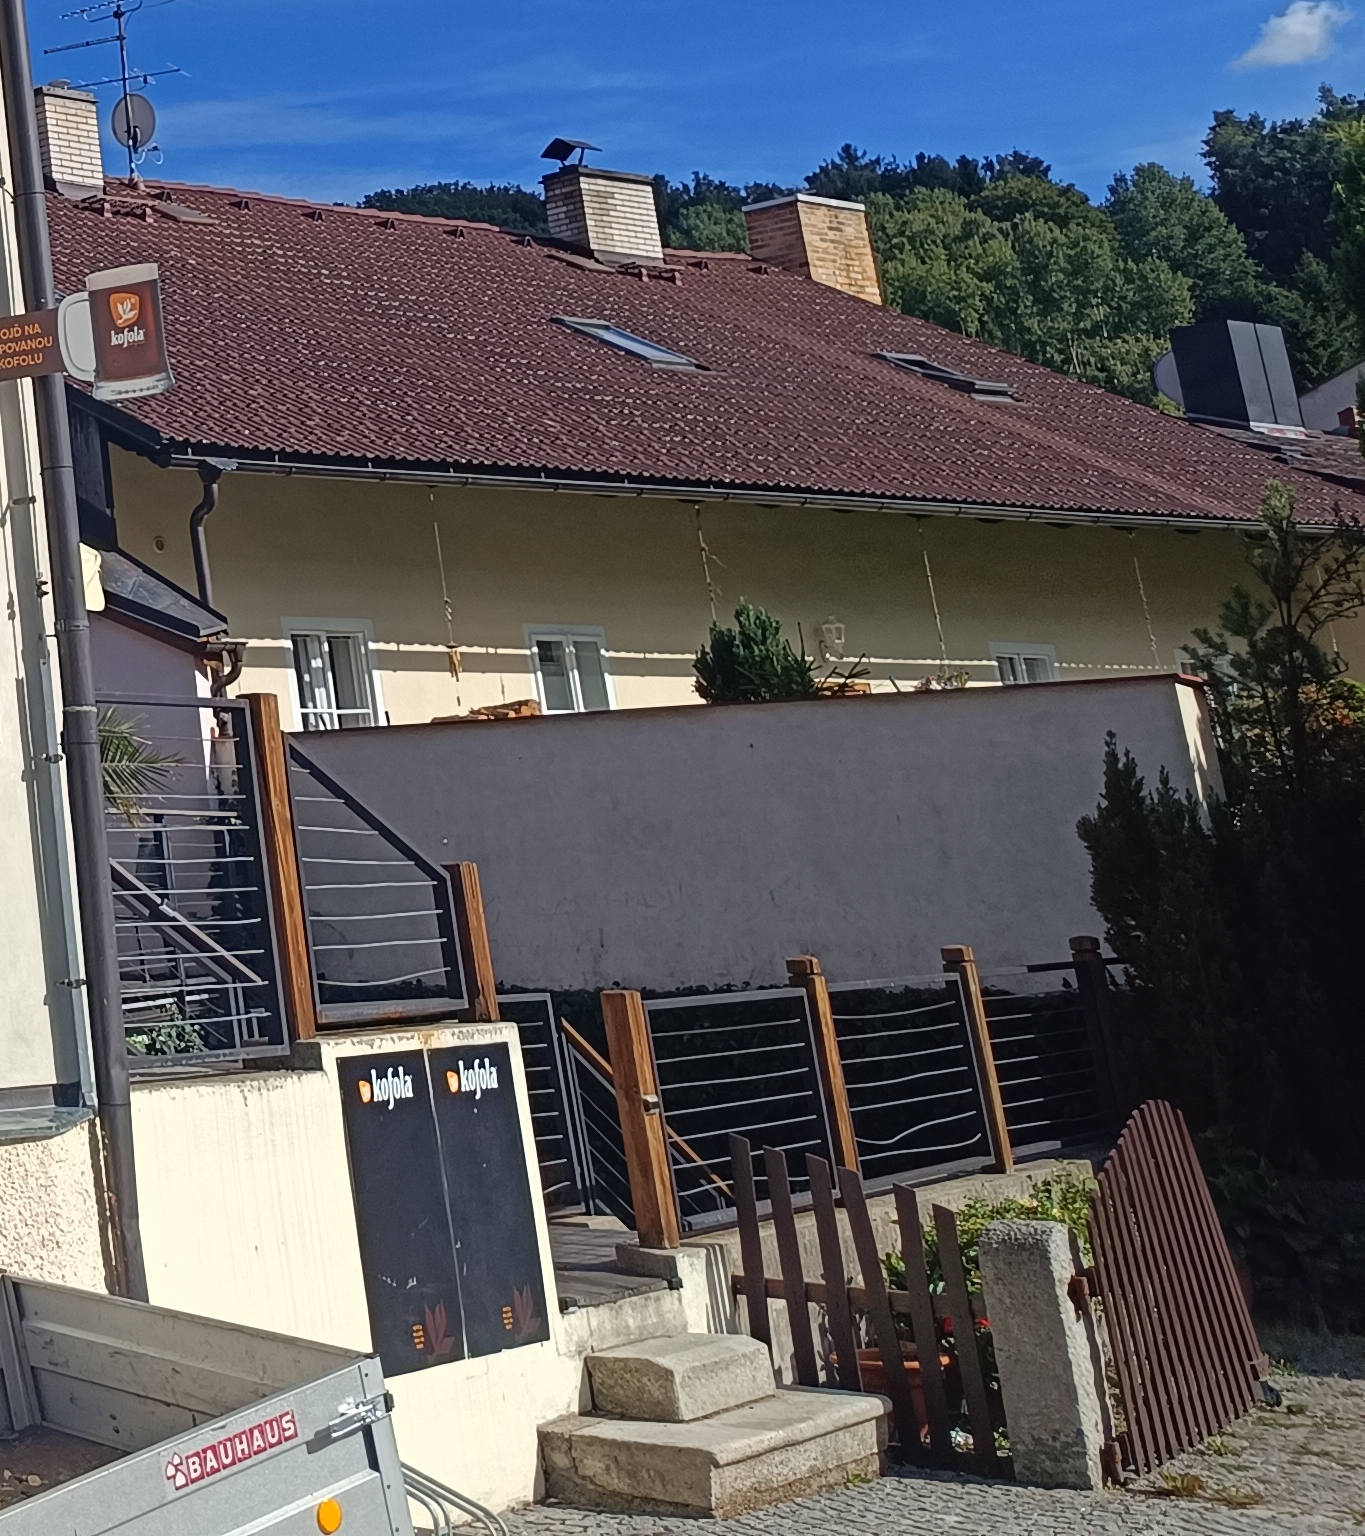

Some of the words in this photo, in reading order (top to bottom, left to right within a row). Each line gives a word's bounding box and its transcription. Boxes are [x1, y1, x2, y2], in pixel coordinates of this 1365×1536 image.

[24, 323, 42, 336] NA
[110, 326, 145, 348] kofola
[370, 1066, 414, 1110] kofola
[458, 1057, 499, 1100] kofola
[187, 1413, 296, 1480] BAUHAUS
